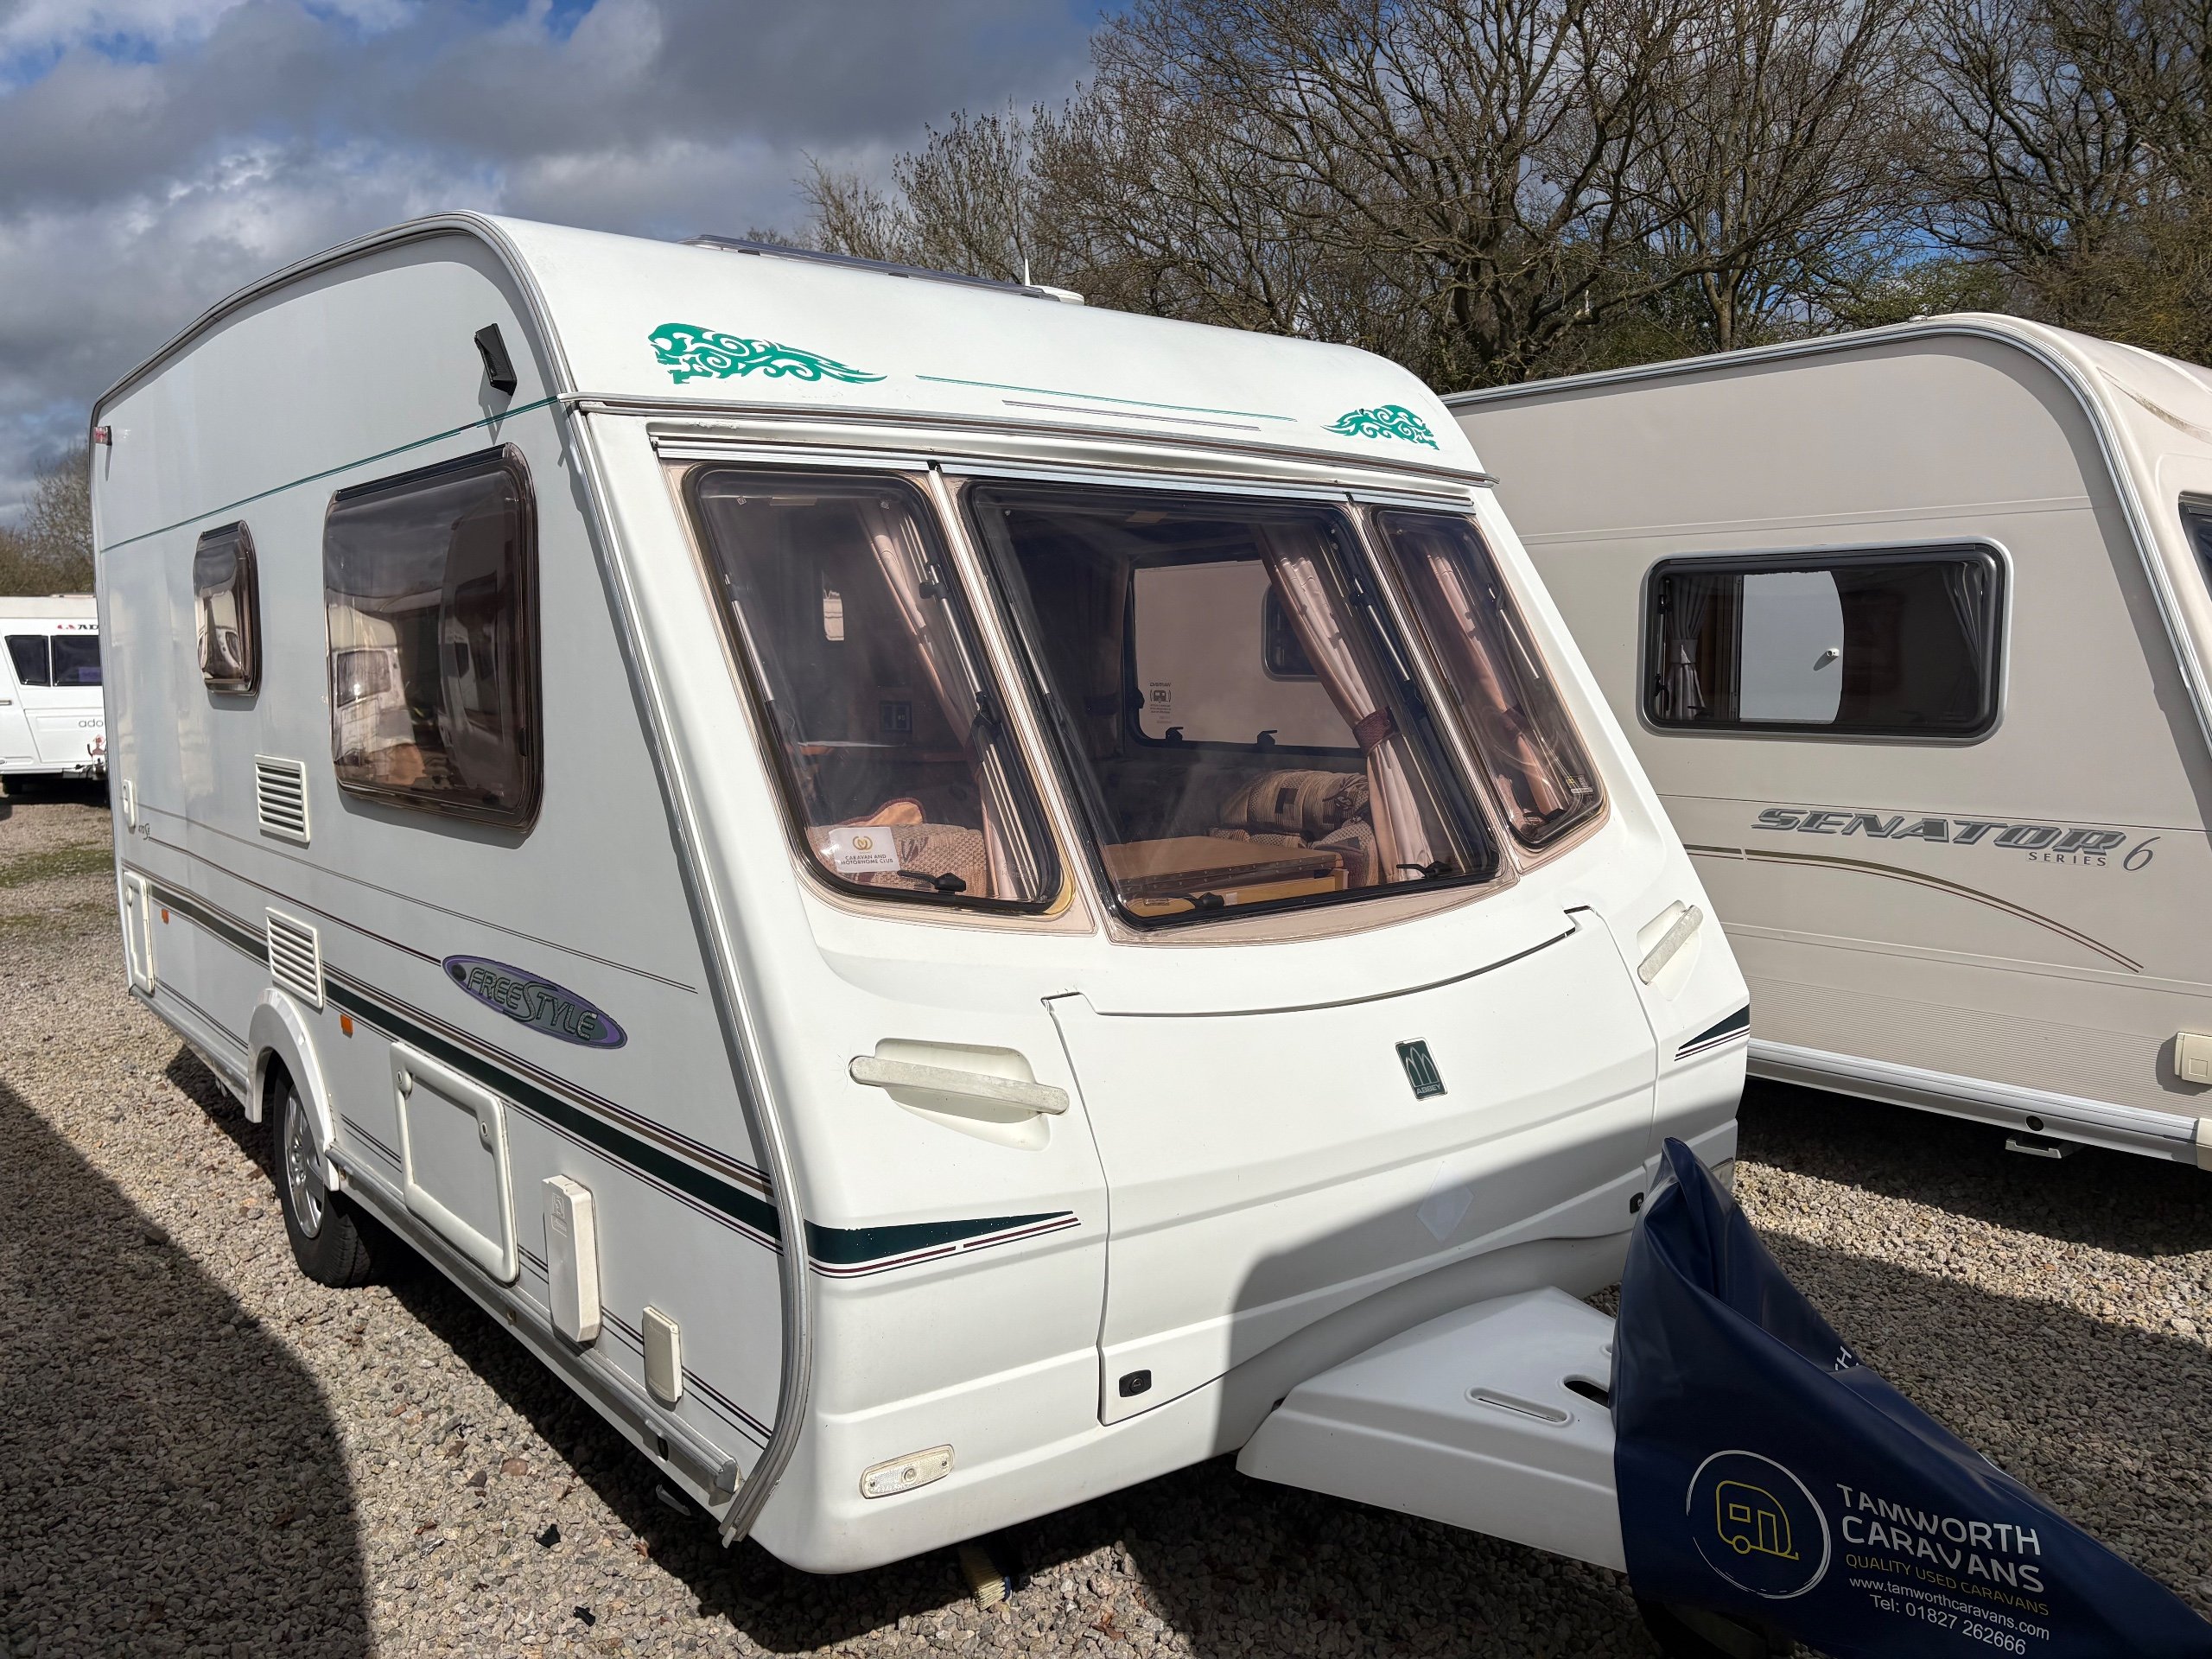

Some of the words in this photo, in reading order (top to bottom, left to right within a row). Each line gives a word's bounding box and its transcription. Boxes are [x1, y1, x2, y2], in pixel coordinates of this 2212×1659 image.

[1751, 808, 2127, 856] SENATOR
[2027, 851, 2107, 868] SERIES
[2122, 836, 2162, 872] 6
[467, 967, 598, 1040] FREESTYLE
[1416, 1084, 1441, 1095] ABBEY
[1836, 1483, 2041, 1556] TAMWORTH
[1841, 1516, 2044, 1593] CARAVANS
[1846, 1554, 1910, 1575] QUALITY
[1916, 1567, 1957, 1589] USED
[1961, 1582, 2050, 1616] CARAVANS
[1849, 1577, 2050, 1641] www.tamworthcaravans.com
[1869, 1594, 1900, 1613] Tel:
[1905, 1602, 1958, 1630] 01827
[1961, 1620, 2026, 1656] 262666
